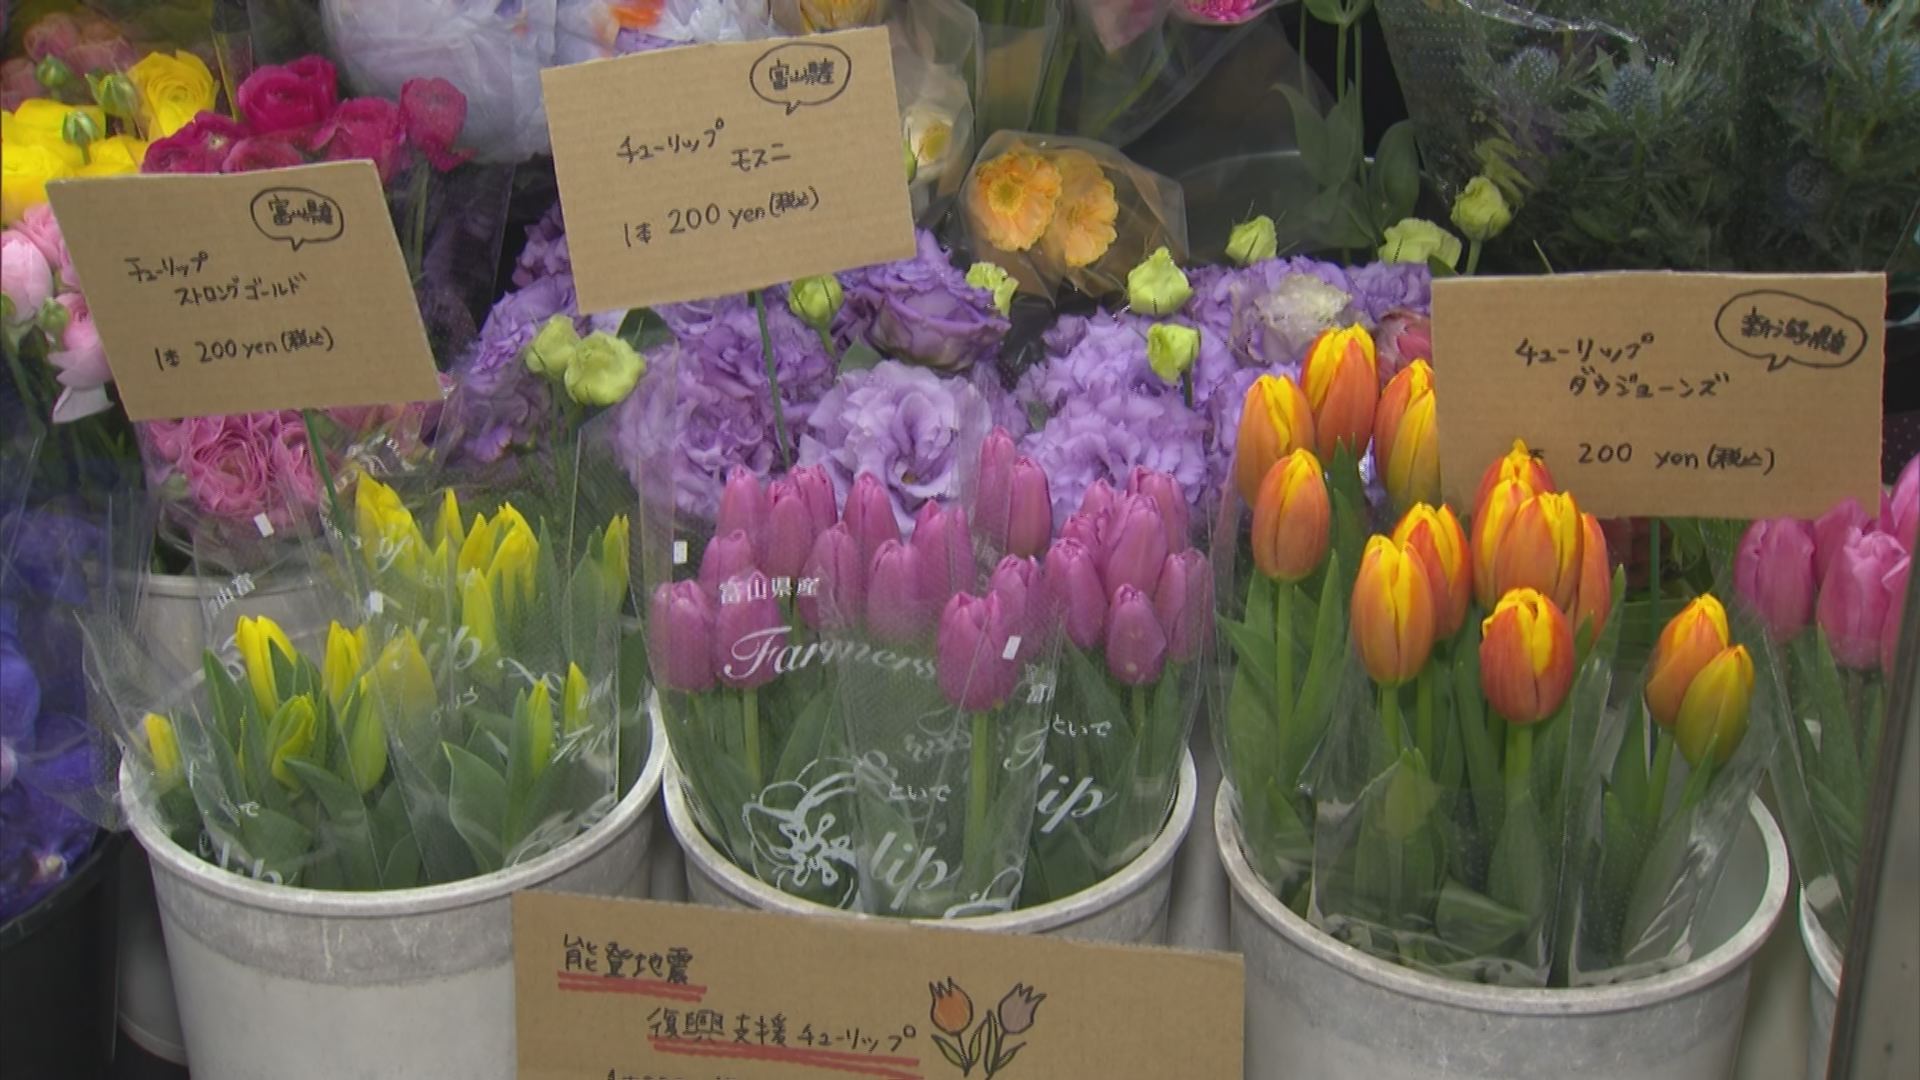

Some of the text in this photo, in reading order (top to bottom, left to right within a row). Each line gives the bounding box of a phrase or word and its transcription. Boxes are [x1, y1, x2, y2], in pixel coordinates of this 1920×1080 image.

[768, 58, 835, 91] 富山県産
[616, 116, 724, 164] チューリップ
[731, 143, 792, 172] モスニ
[267, 193, 333, 226] 富山県産
[668, 203, 721, 235] 200
[124, 250, 209, 283] チューリップ
[1741, 306, 1848, 356] 新潟県産
[195, 339, 237, 363] 200
[1514, 332, 1655, 367] チューリップ
[1578, 443, 1633, 464] 200
[719, 575, 820, 605] 富山県産
[723, 625, 937, 679] Farmers
[564, 933, 694, 985] 能登地震
